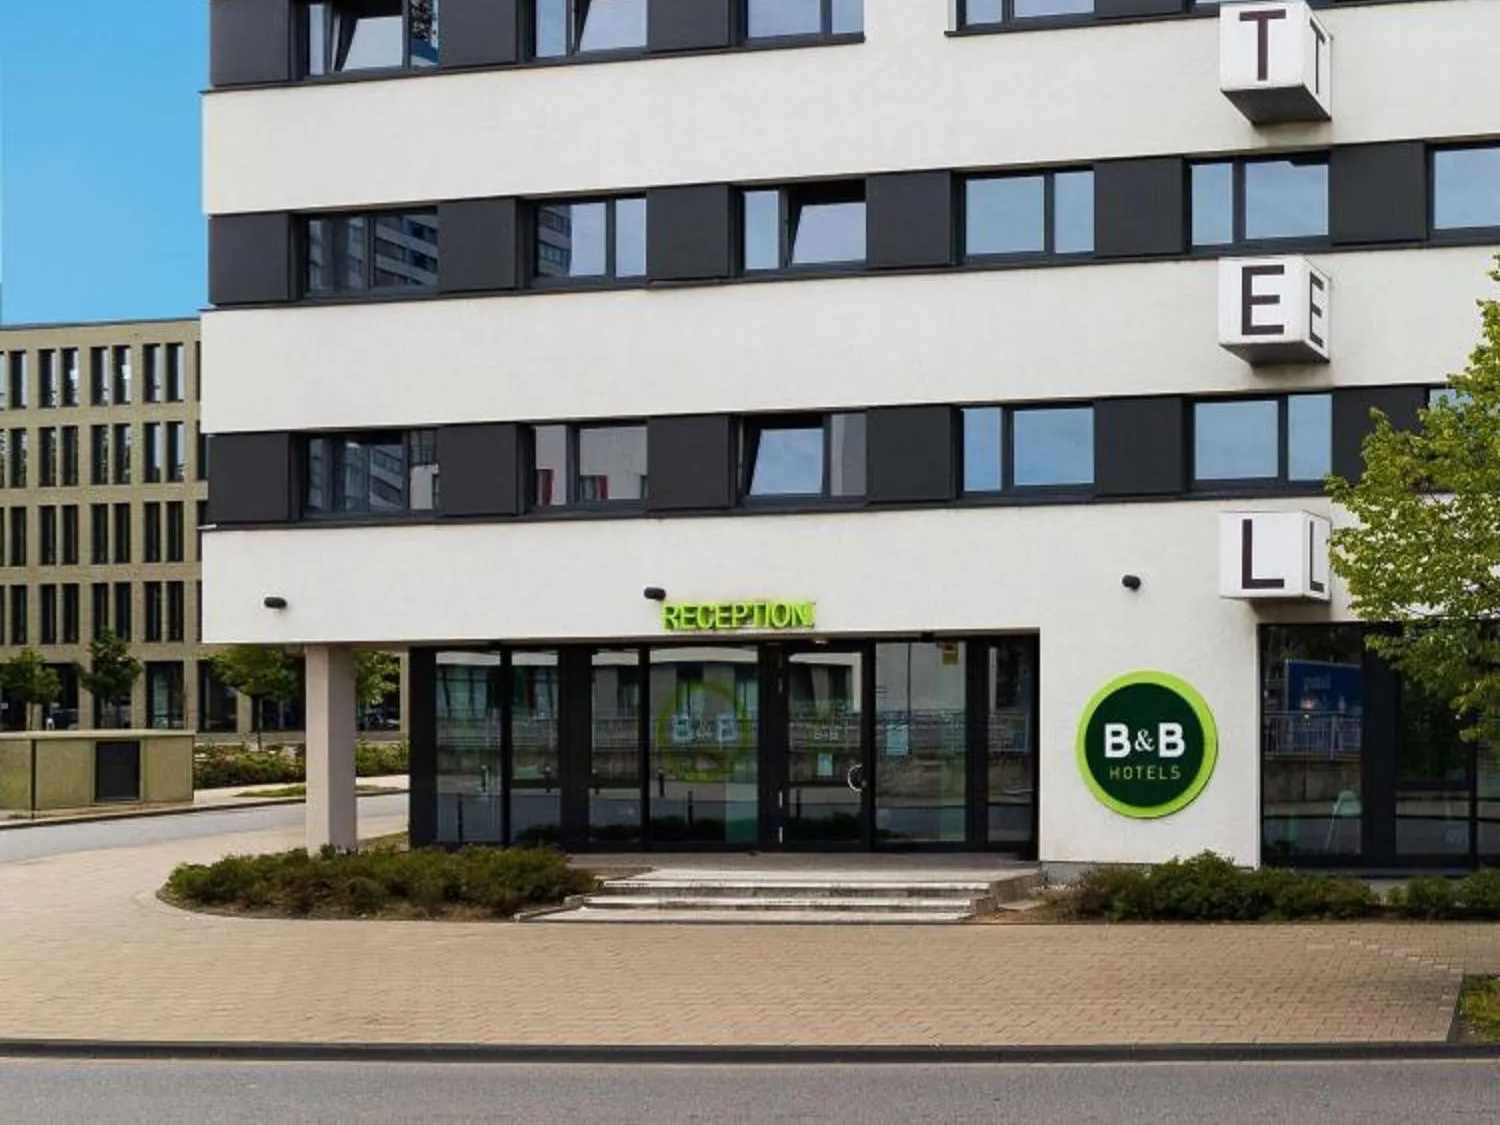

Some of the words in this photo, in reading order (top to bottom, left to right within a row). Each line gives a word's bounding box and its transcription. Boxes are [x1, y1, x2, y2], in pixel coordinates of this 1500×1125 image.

[662, 603, 816, 631] RECEPTION
[1104, 722, 1187, 758] B&B
[1109, 765, 1182, 780] HOTELS
